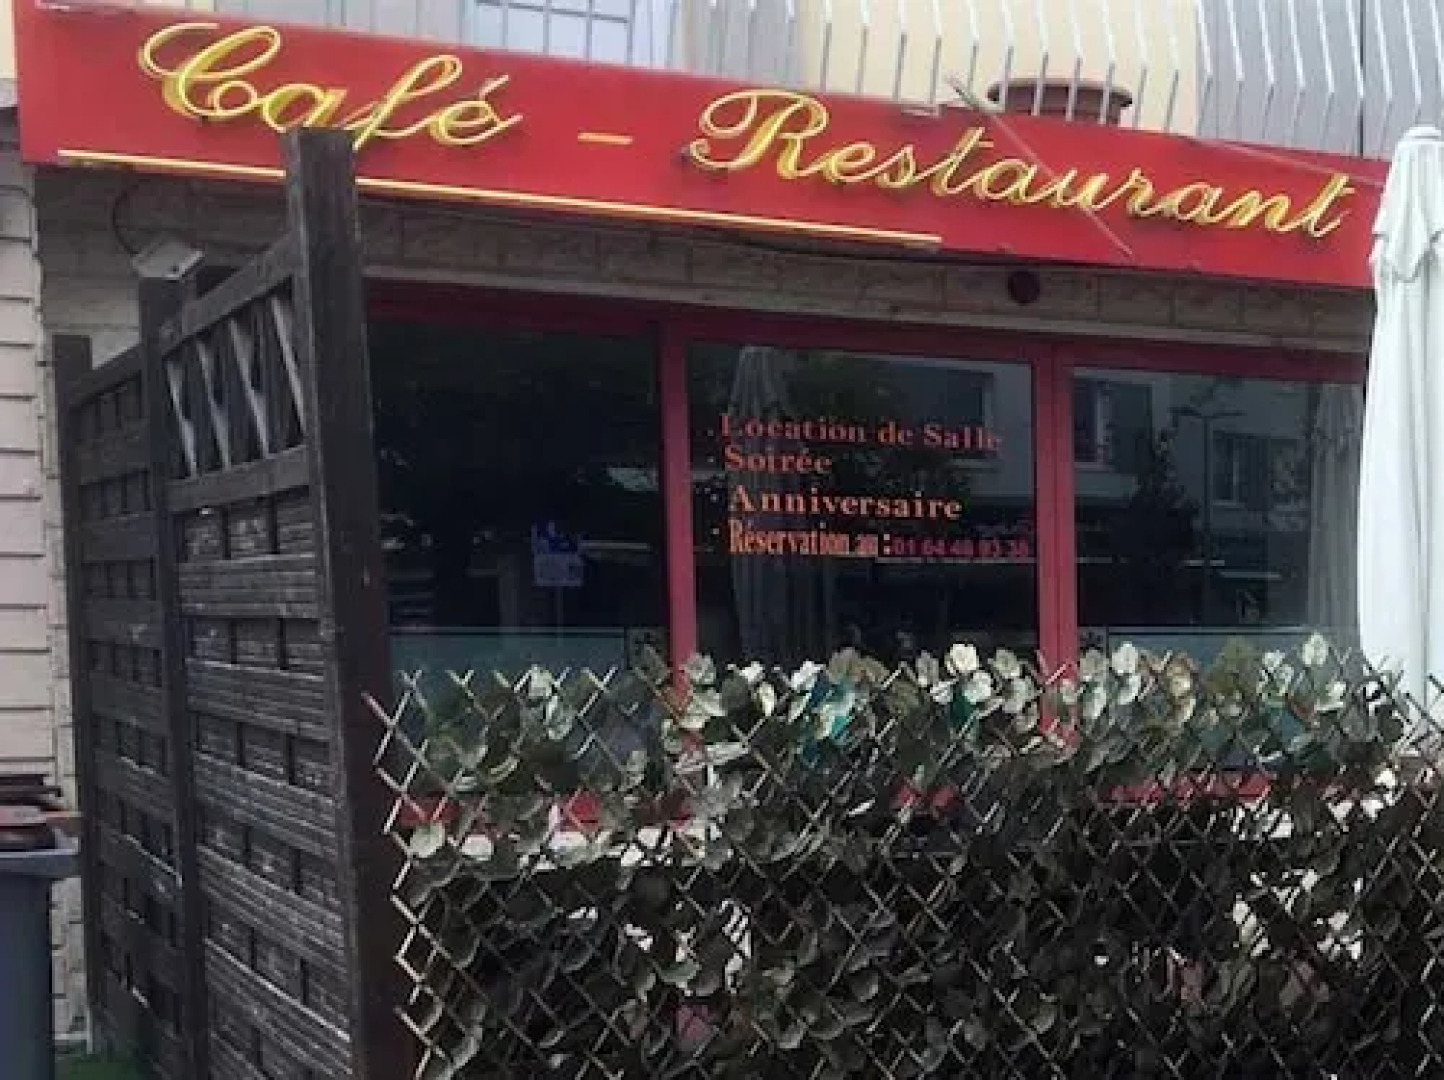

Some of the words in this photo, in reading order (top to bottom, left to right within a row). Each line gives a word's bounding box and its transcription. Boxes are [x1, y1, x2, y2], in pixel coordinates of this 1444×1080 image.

[138, 22, 522, 152] Café
[688, 88, 1356, 239] Restaurant
[721, 414, 867, 443] Location
[877, 420, 914, 447] de
[922, 422, 1003, 450] Salle
[723, 443, 834, 474] Soirée
[731, 484, 964, 520] Anniversaire
[729, 517, 851, 555] Réservation
